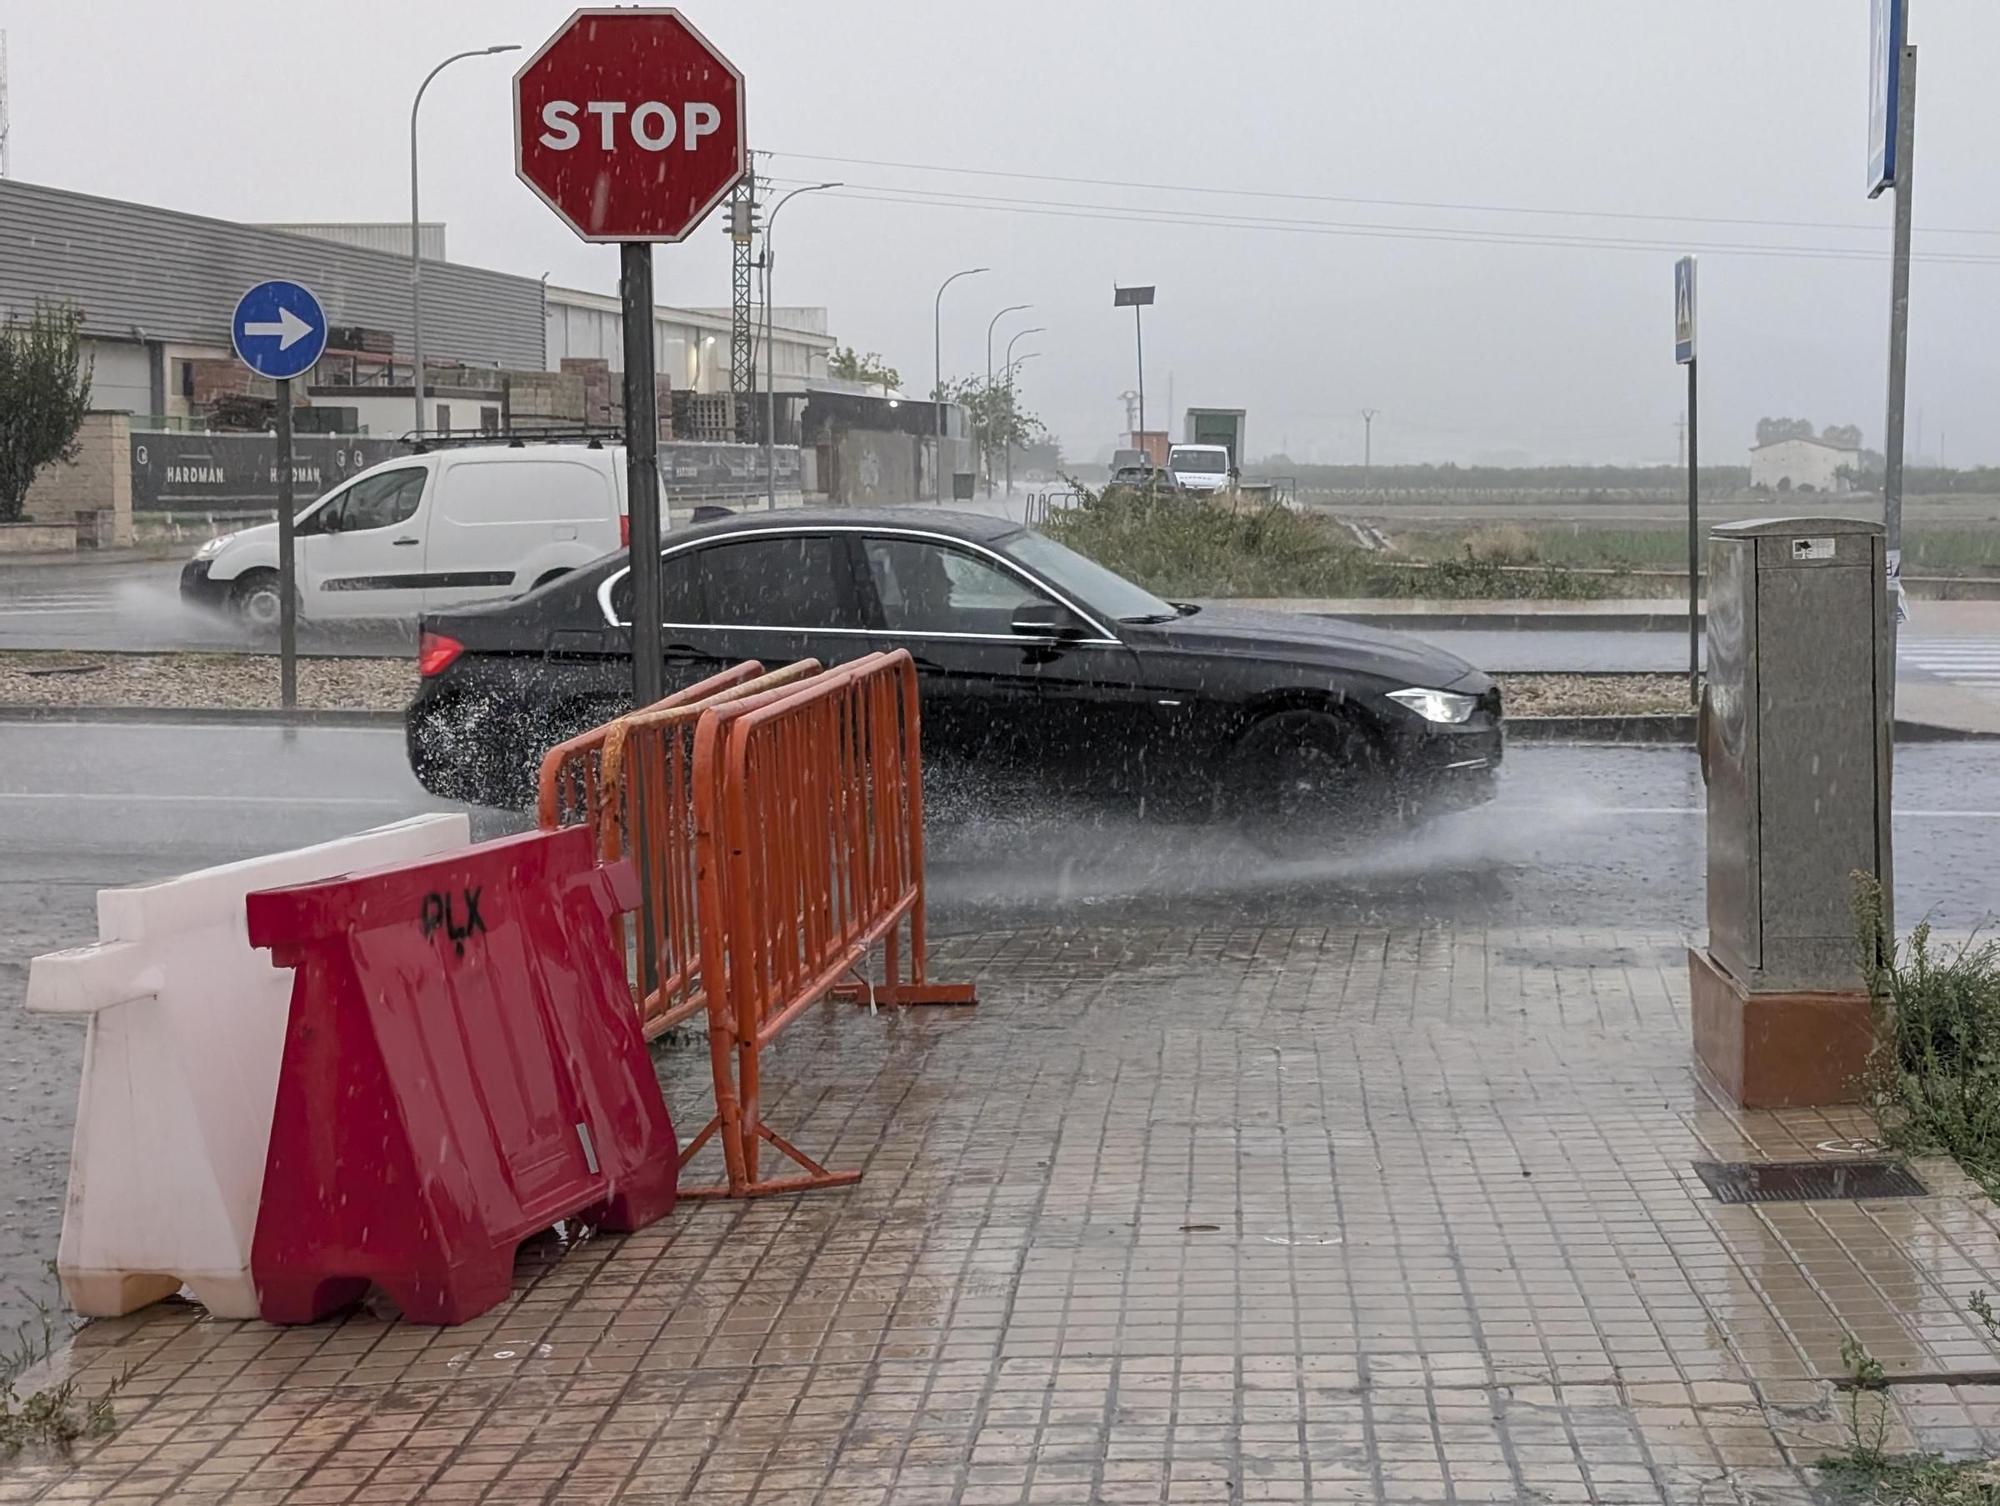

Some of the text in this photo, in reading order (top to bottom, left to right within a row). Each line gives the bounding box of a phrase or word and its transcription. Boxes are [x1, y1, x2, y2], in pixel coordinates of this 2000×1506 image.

[538, 100, 721, 152] STOP
[167, 466, 224, 484] HARDMAN
[270, 467, 320, 482] HDMAN
